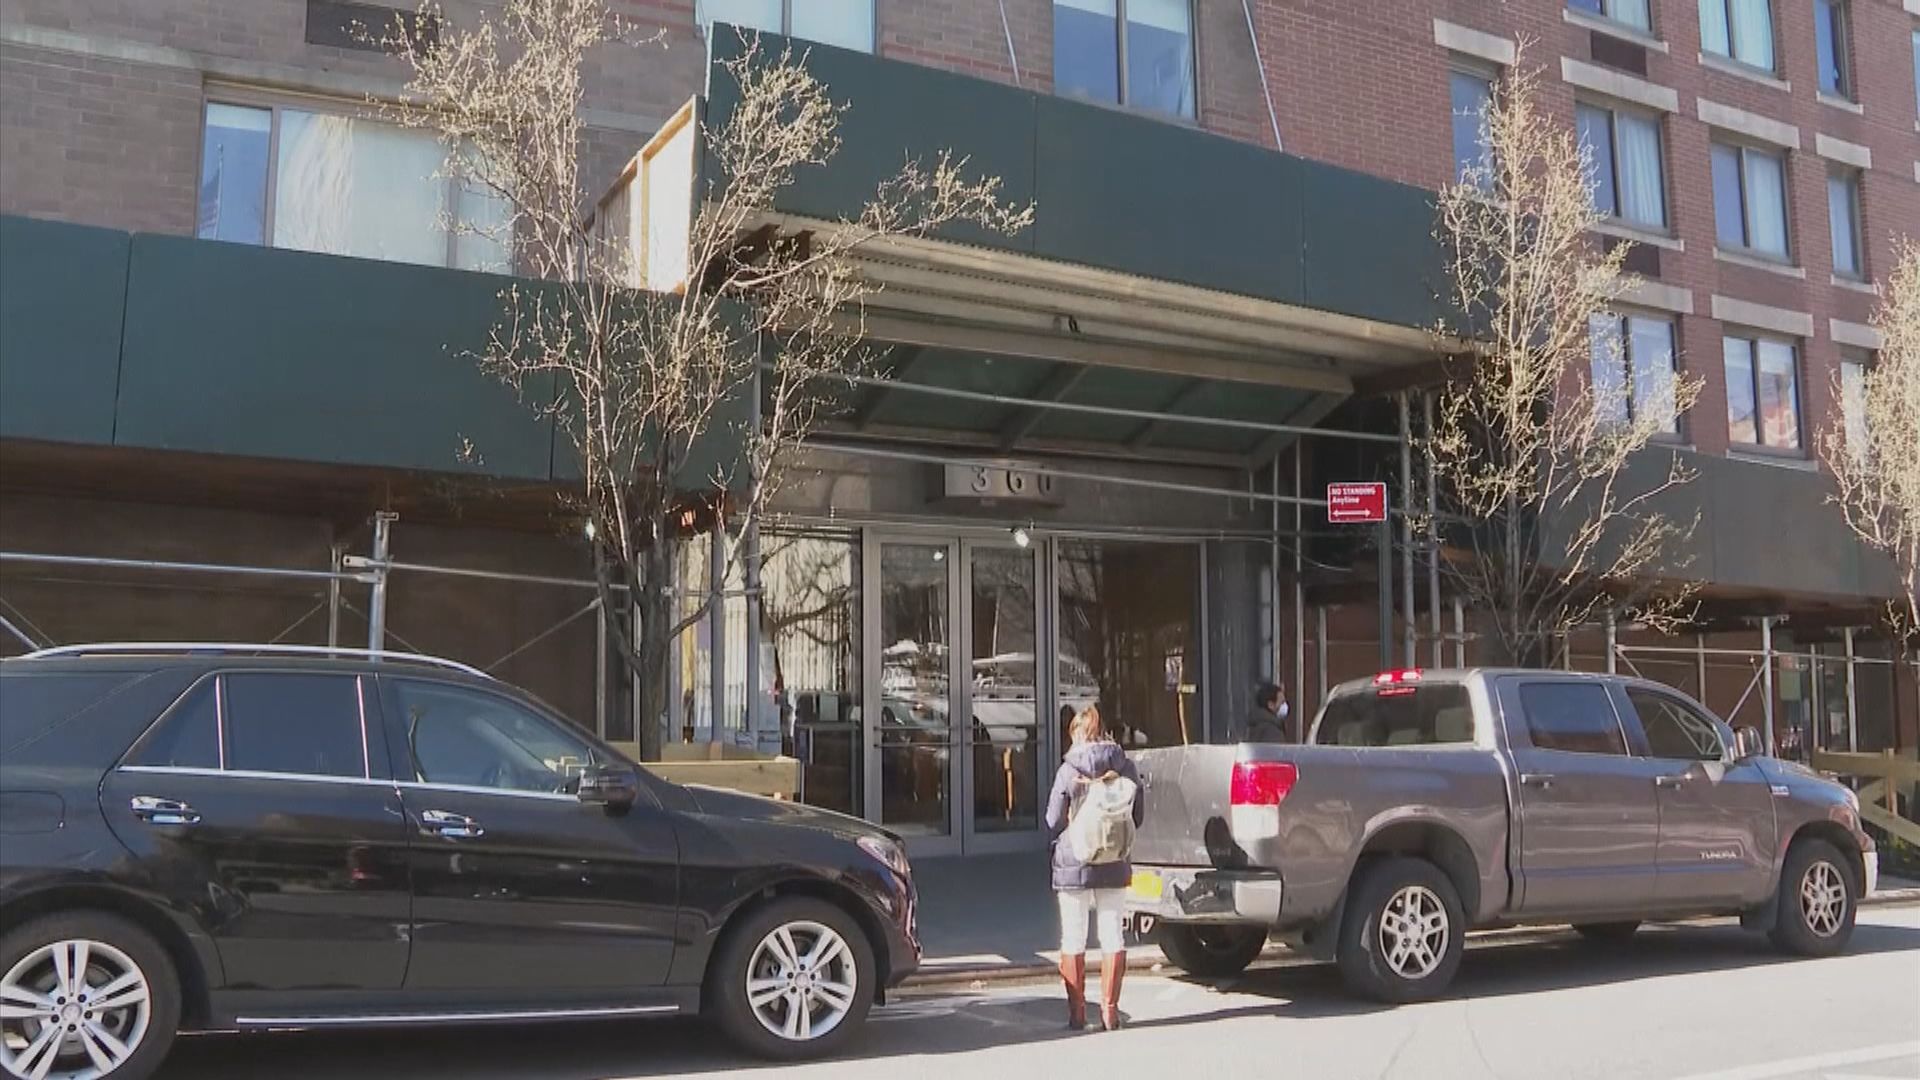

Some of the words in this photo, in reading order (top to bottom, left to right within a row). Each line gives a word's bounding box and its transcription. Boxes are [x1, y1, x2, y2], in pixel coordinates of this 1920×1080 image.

[970, 464, 1054, 496] 360
[1331, 487, 1342, 496] NO
[1343, 486, 1376, 496] STANDING
[1332, 495, 1360, 505] Anytime
